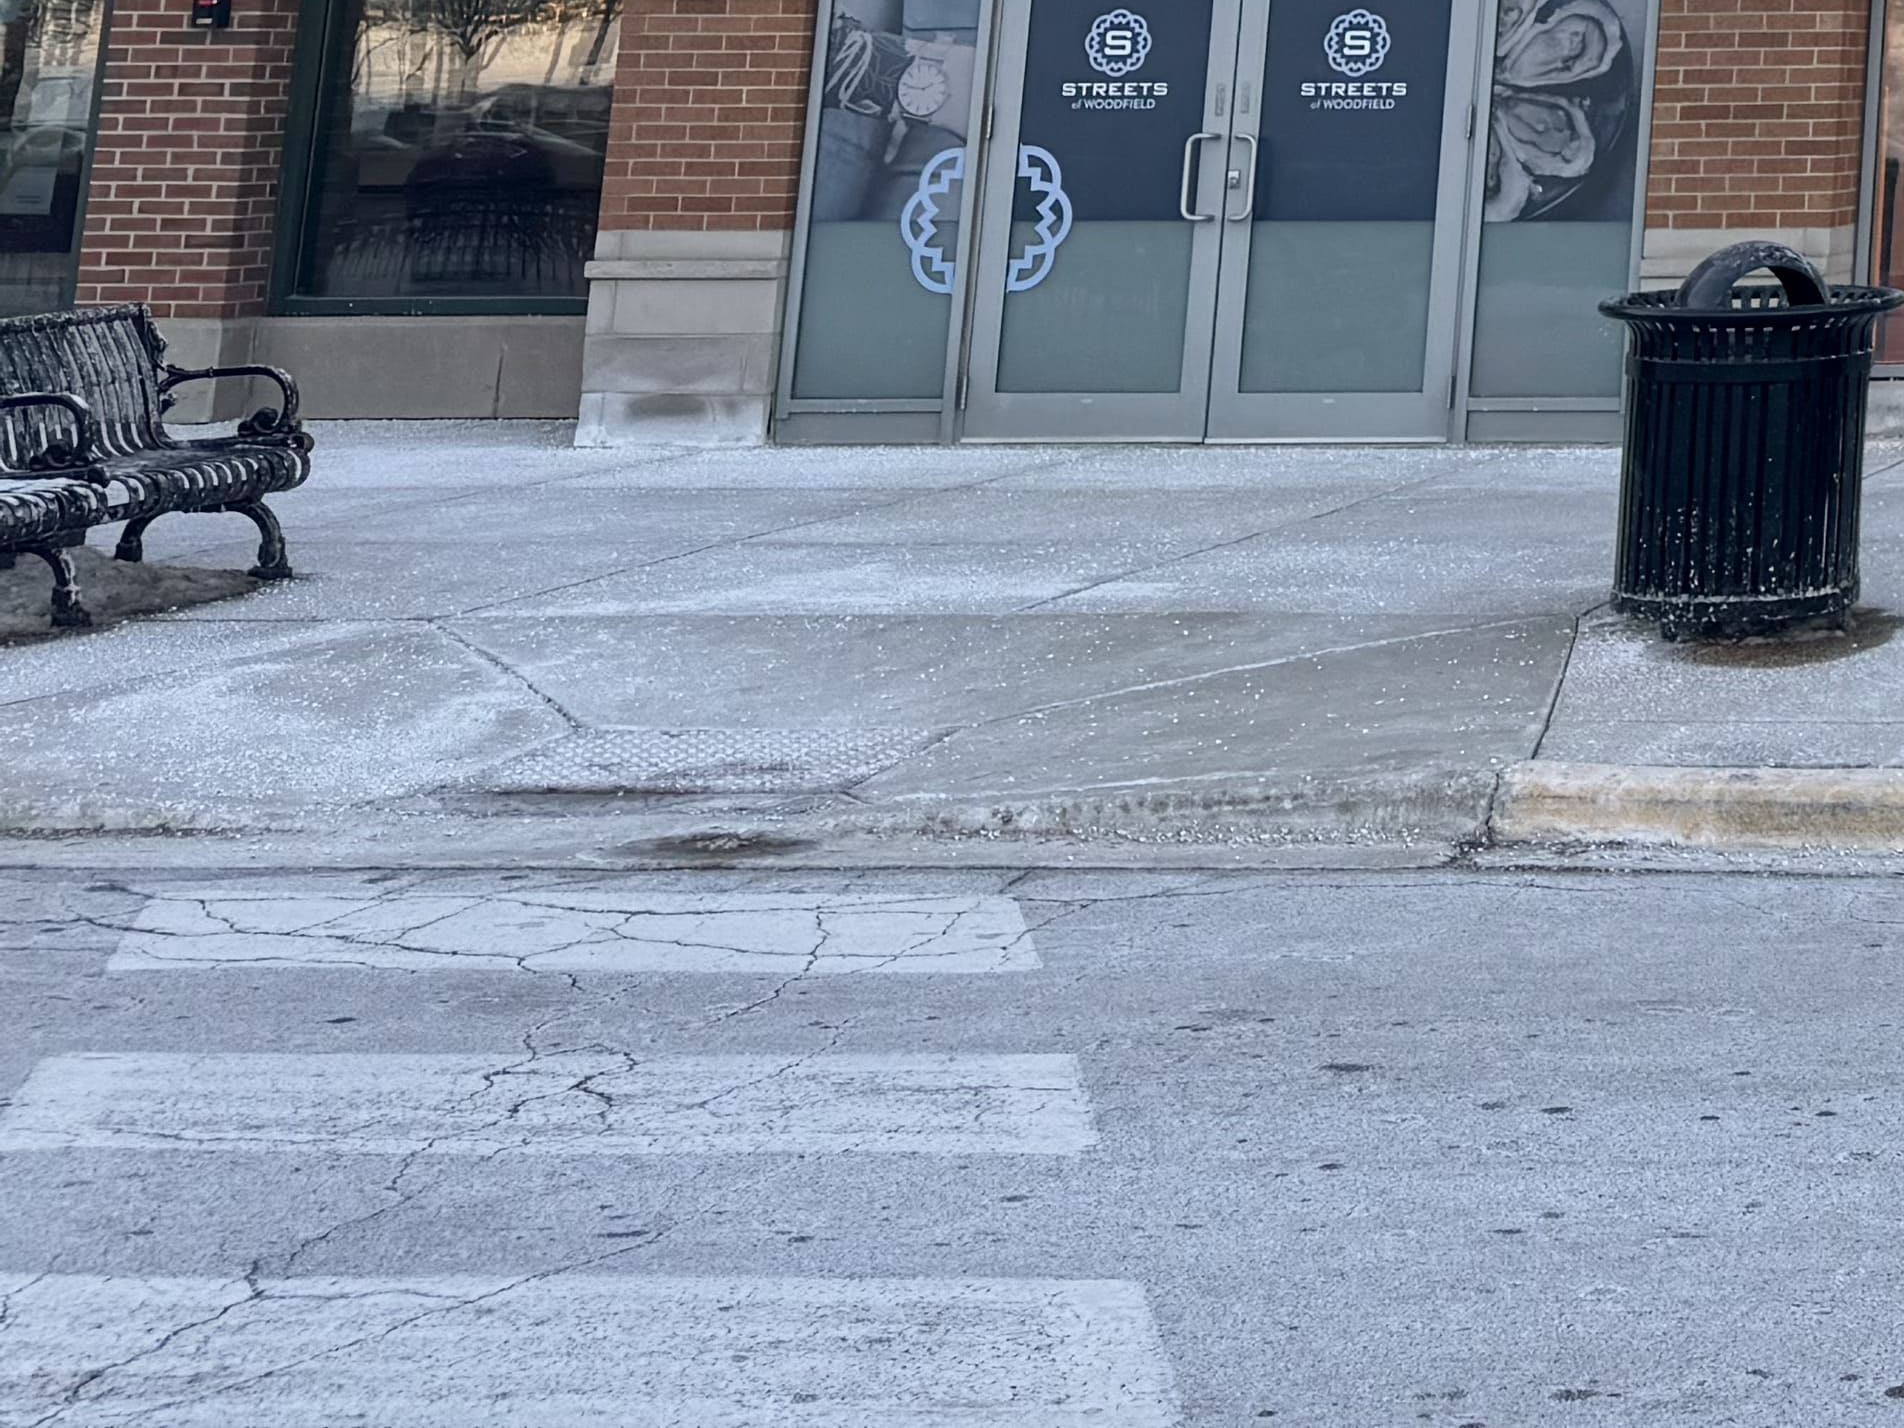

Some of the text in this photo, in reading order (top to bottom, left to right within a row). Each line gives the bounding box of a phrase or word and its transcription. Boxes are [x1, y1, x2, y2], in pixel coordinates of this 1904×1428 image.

[1062, 82, 1168, 97] STREETS
[1300, 82, 1407, 97] STREETS
[1083, 99, 1156, 110] WOODFIELD
[1322, 99, 1395, 110] WOODFIELD
